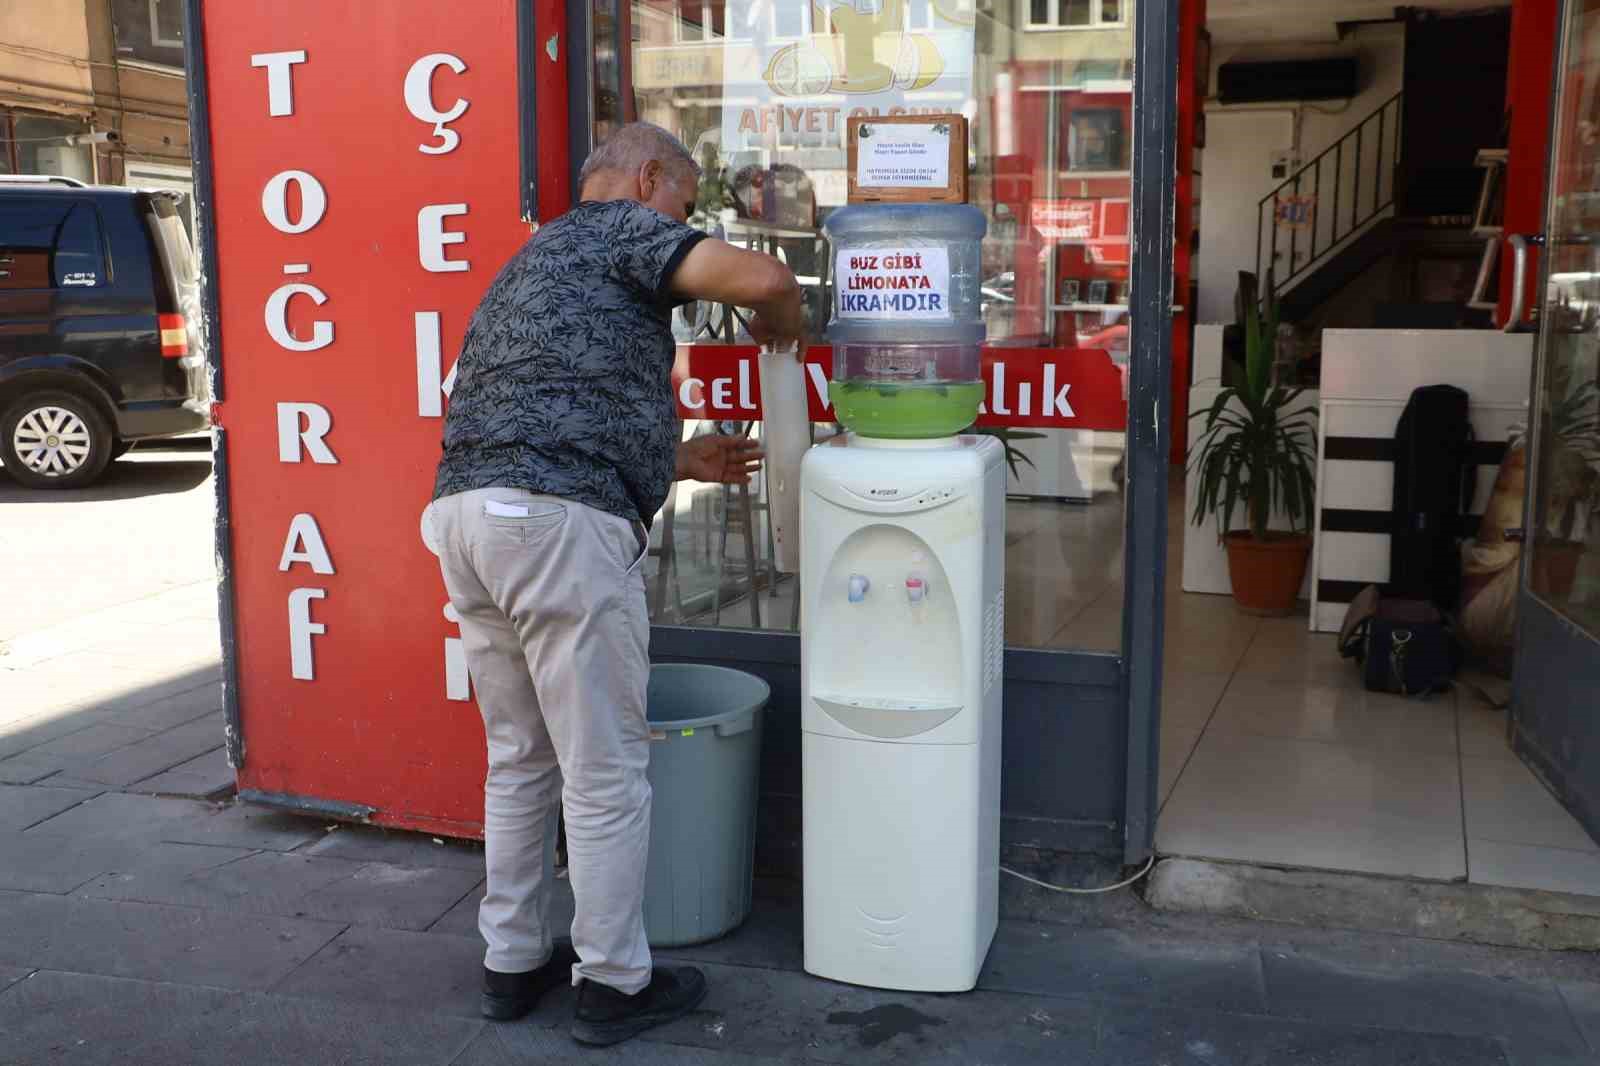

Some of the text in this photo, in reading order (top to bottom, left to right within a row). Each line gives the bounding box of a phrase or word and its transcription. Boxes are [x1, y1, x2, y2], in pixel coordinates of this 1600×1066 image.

[737, 103, 840, 133] AFİYET
[850, 252, 922, 270] BUZ GİBİ
[848, 273, 932, 290] LİMONATA
[841, 290, 943, 312] İKRAMDIR
